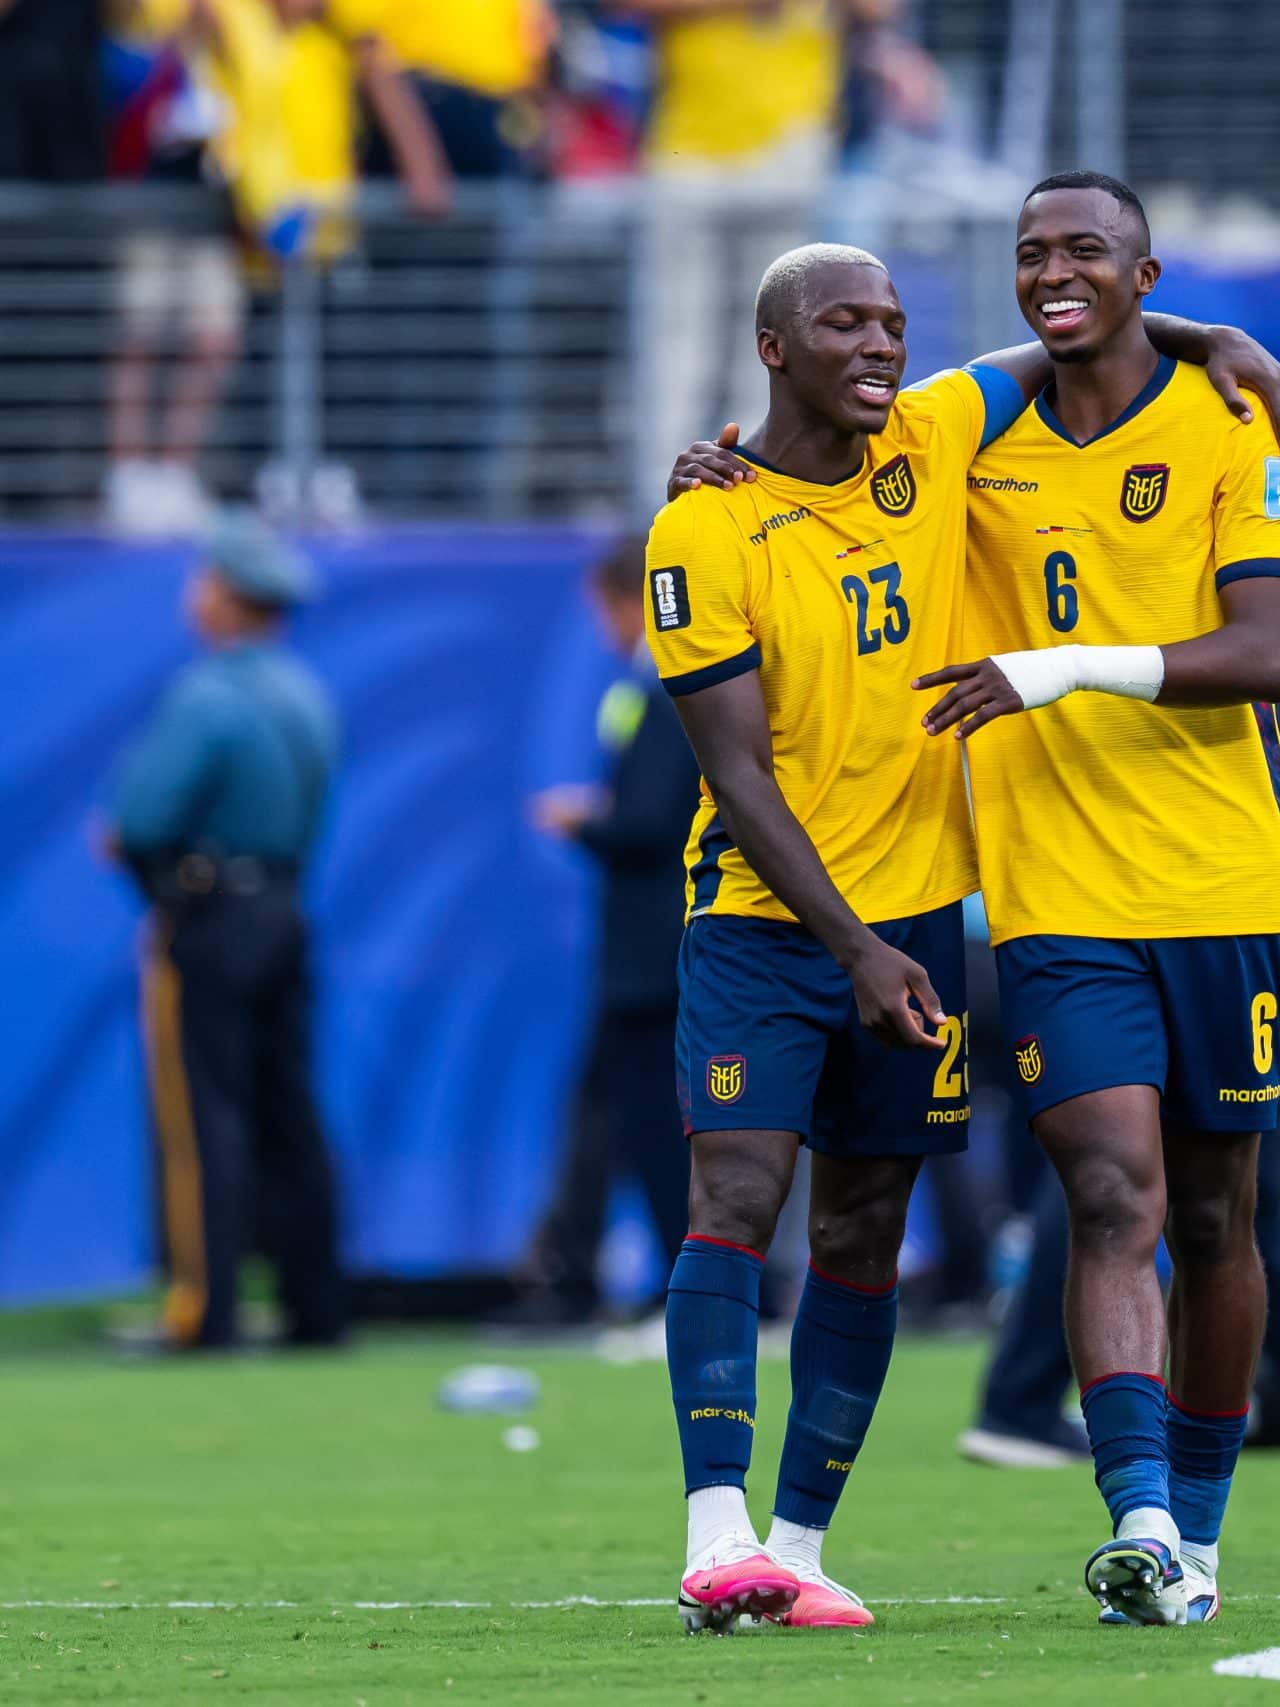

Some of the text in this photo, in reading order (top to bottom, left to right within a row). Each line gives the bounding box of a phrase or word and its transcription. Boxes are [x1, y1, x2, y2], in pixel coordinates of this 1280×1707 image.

[967, 476, 1039, 493] marathon
[841, 561, 910, 656] 23
[1044, 550, 1078, 632] 6
[933, 1010, 969, 1098] 2
[1251, 991, 1277, 1074] 6
